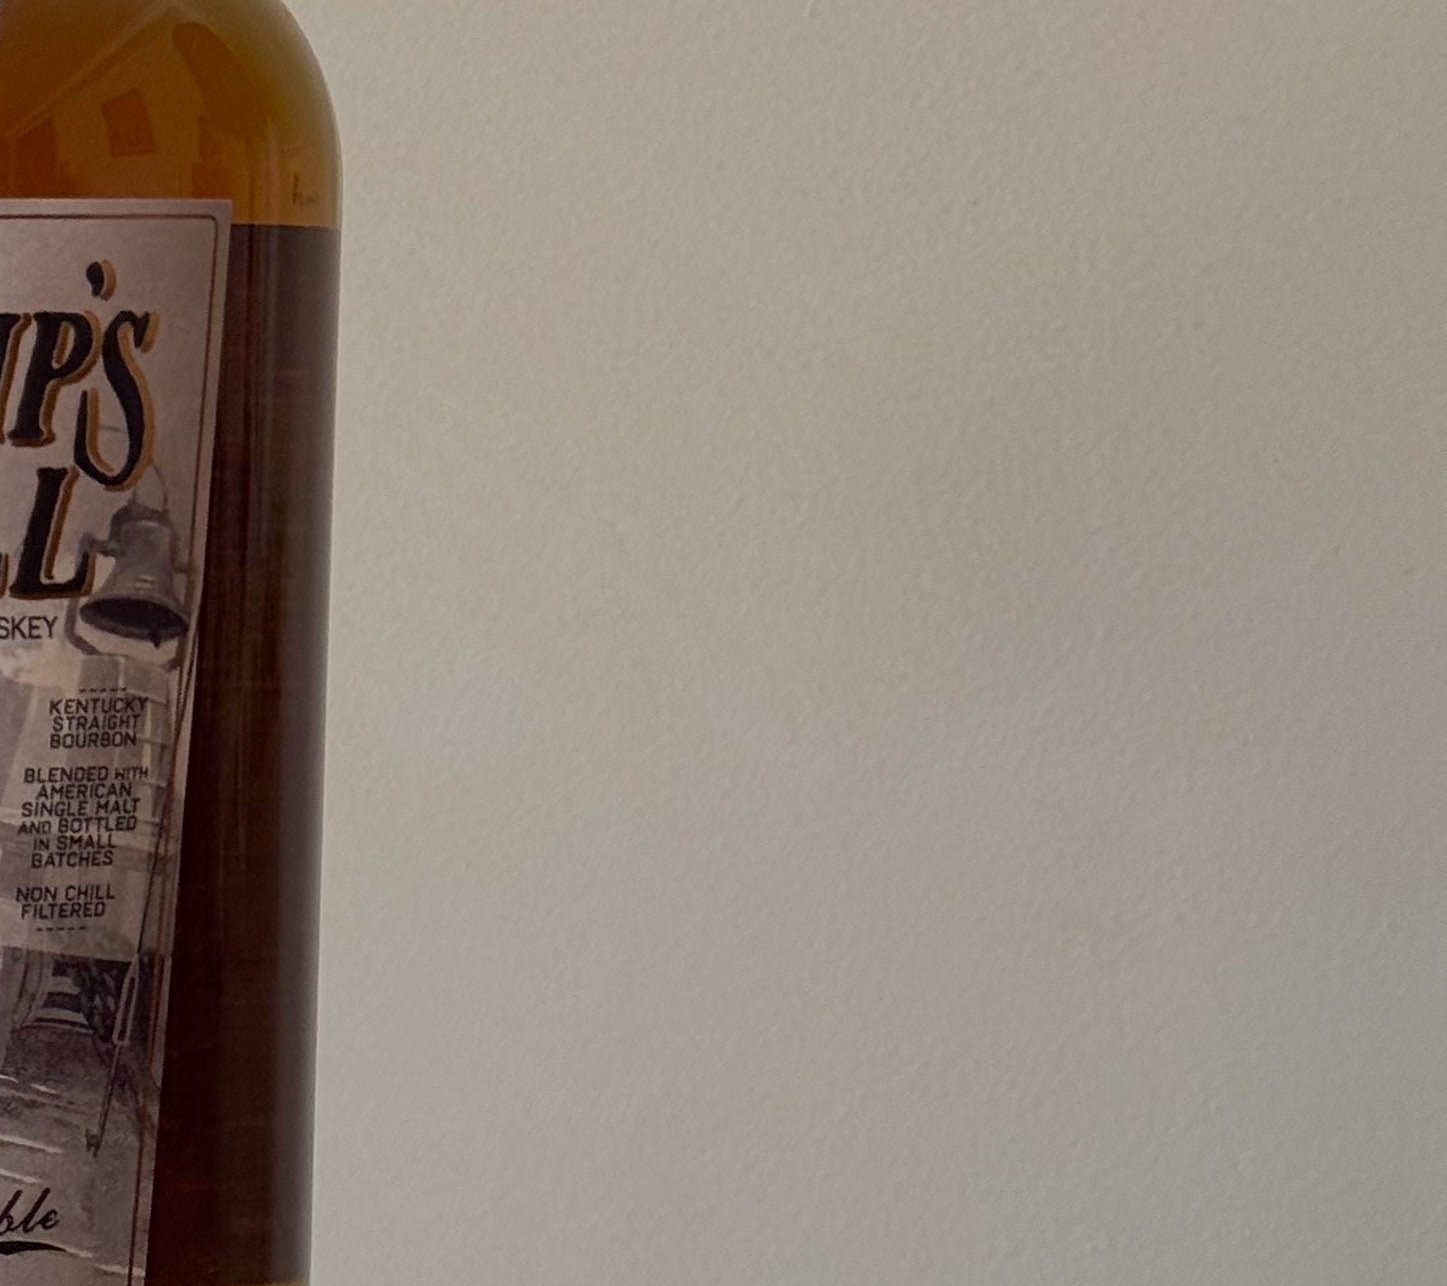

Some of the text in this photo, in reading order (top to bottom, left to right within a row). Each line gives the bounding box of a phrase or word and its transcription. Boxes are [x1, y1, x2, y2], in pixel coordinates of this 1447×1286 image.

[49, 697, 149, 715] KENTUCKY
[52, 714, 140, 732] STRAIGHT
[50, 732, 137, 749] BOURBON
[24, 766, 149, 783] BLENDED WITH
[36, 782, 132, 800] AMERICAN
[21, 798, 140, 817] SINGLE MALT
[18, 815, 137, 835] AND BOTTLED
[33, 834, 116, 851] IN SMALL
[31, 850, 114, 868] BATCHES
[15, 884, 115, 902] NON CHILL
[21, 902, 106, 919] FILTERED
